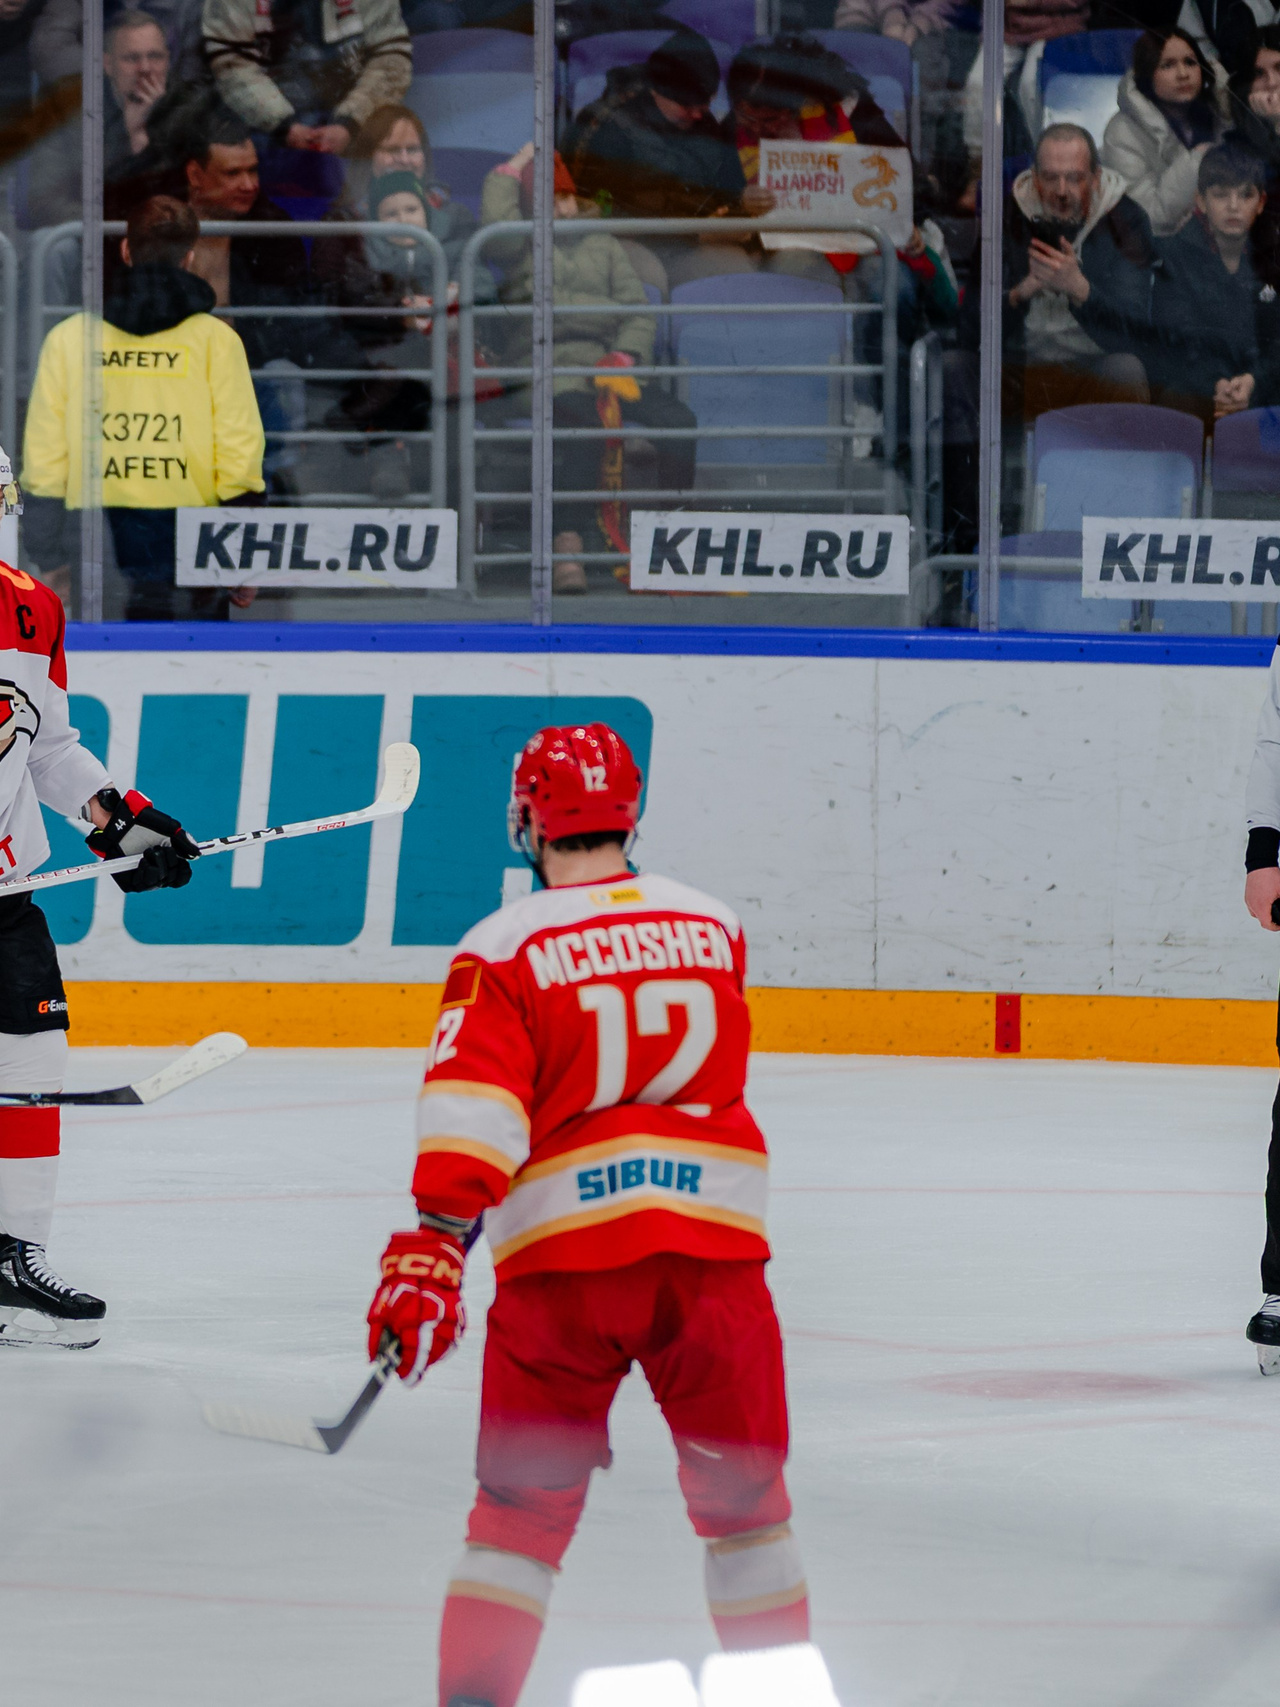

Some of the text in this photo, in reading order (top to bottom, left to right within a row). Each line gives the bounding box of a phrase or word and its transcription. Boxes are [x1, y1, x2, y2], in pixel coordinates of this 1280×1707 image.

[104, 456, 188, 479] AFETY
[194, 522, 440, 572] KHL.RU
[648, 527, 893, 579] KHL.RU
[16, 604, 36, 640] C
[581, 765, 609, 793] 12
[114, 818, 127, 831] 44
[525, 920, 734, 990] MCCOSHEN
[577, 979, 718, 1118] 12
[577, 1158, 702, 1201] SIBUR
[382, 1253, 462, 1287] CCM
